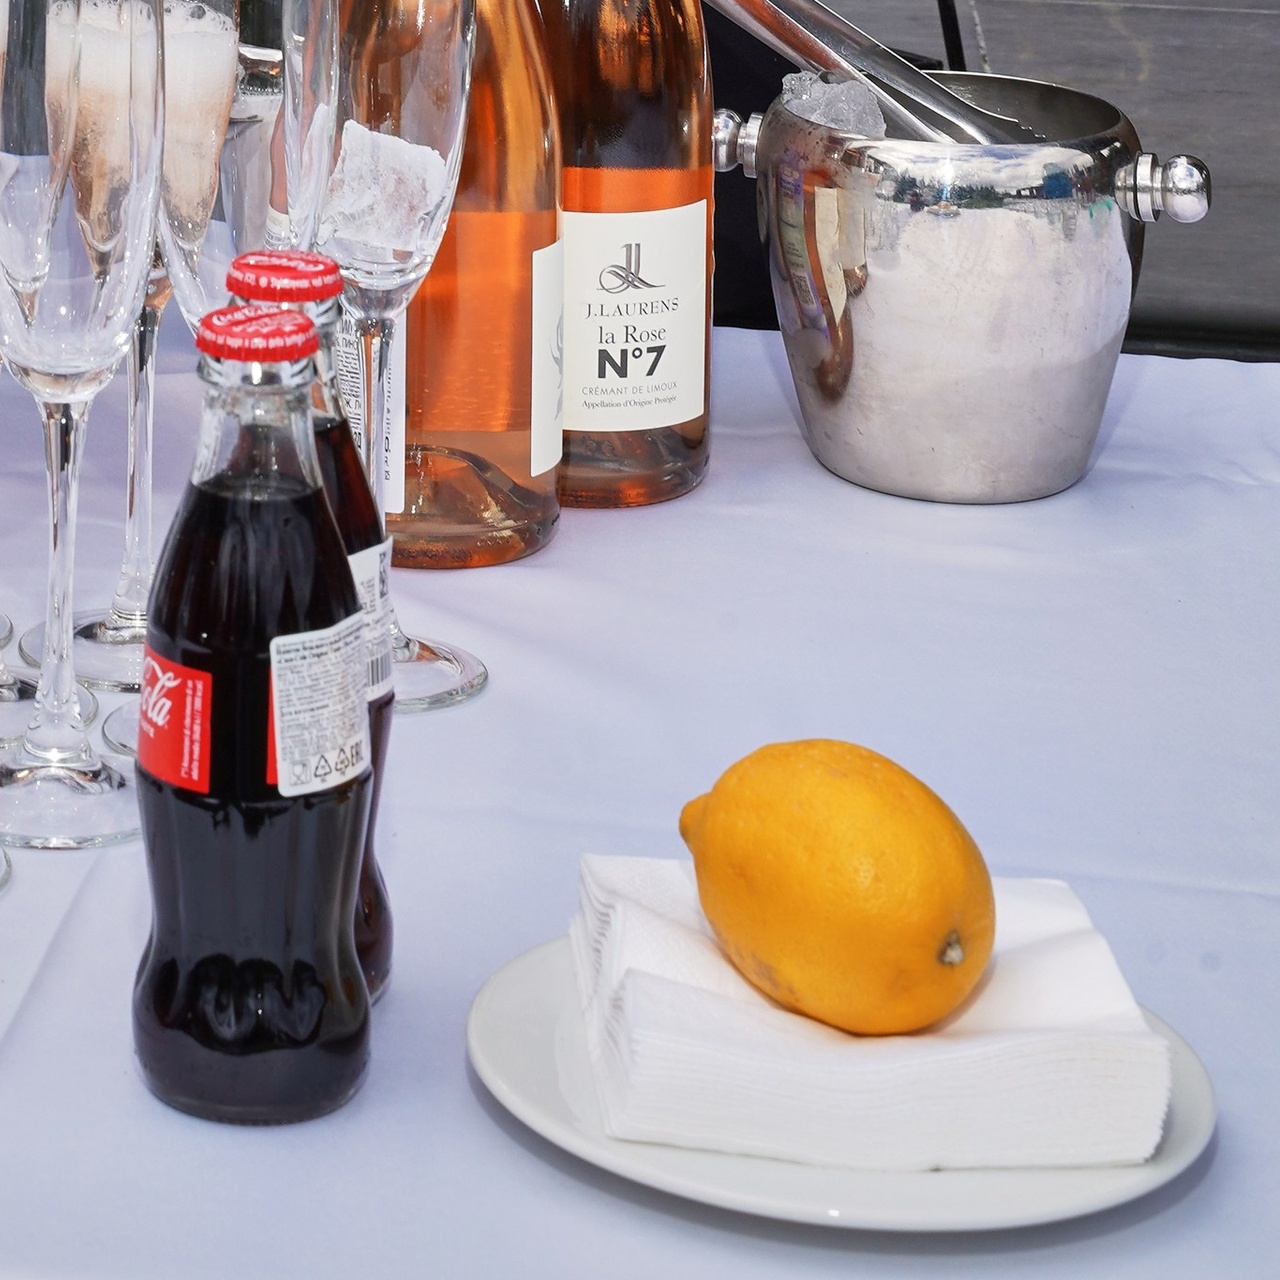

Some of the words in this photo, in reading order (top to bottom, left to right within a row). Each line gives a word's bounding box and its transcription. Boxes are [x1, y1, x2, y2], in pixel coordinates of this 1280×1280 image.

[585, 297, 679, 320] J.LAURENS
[598, 325, 616, 344] la
[623, 324, 667, 344] Rose
[597, 344, 667, 379] N°7
[631, 385, 643, 395] DE
[646, 380, 678, 394] LIMOUX
[581, 399, 622, 410] Appellation
